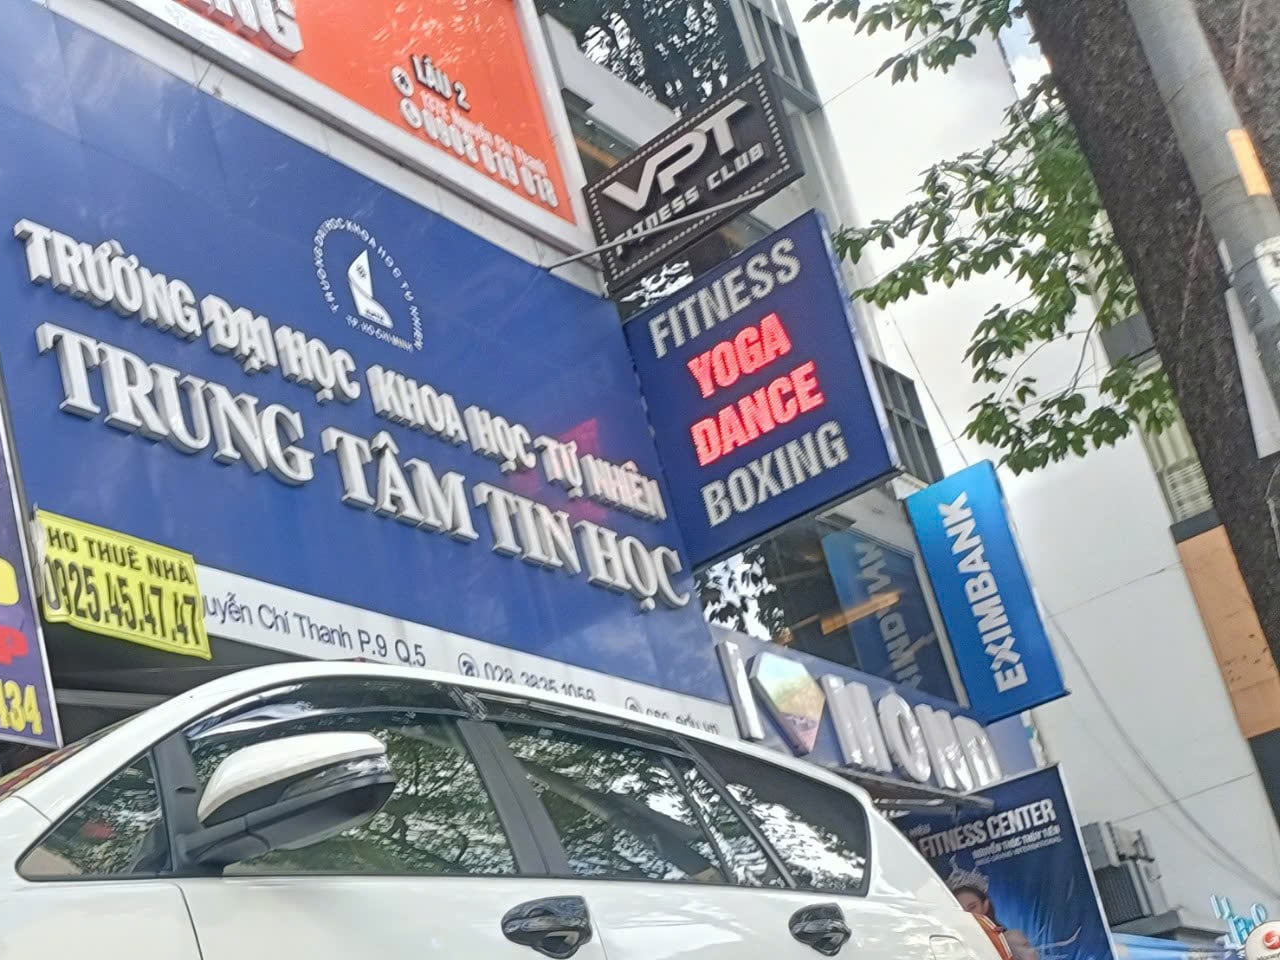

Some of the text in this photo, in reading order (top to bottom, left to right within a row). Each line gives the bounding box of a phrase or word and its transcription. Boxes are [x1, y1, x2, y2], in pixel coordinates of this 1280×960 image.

[453, 81, 471, 112] 2
[602, 99, 747, 212] VPT
[706, 142, 764, 190] CLUB
[648, 238, 801, 358] FITNESS
[13, 218, 667, 521] TRƯỜNG ĐẠI HỌC KHOA HỌC TỰ NHIÊN
[687, 313, 792, 398] YOGA
[35, 321, 690, 613] TRUNG TÂM TIN HỌC
[690, 361, 825, 467] DANCE
[700, 420, 849, 527] BOXING
[44, 525, 193, 584] HO THUÊ NHÀ
[937, 491, 1028, 693] EXIMBANK
[202, 591, 253, 625] uyễn
[258, 604, 291, 634] Chí
[293, 612, 354, 650] Thanh
[358, 629, 388, 658] P.9
[918, 819, 987, 858] FITNESS
[986, 798, 1057, 840] CENTER
